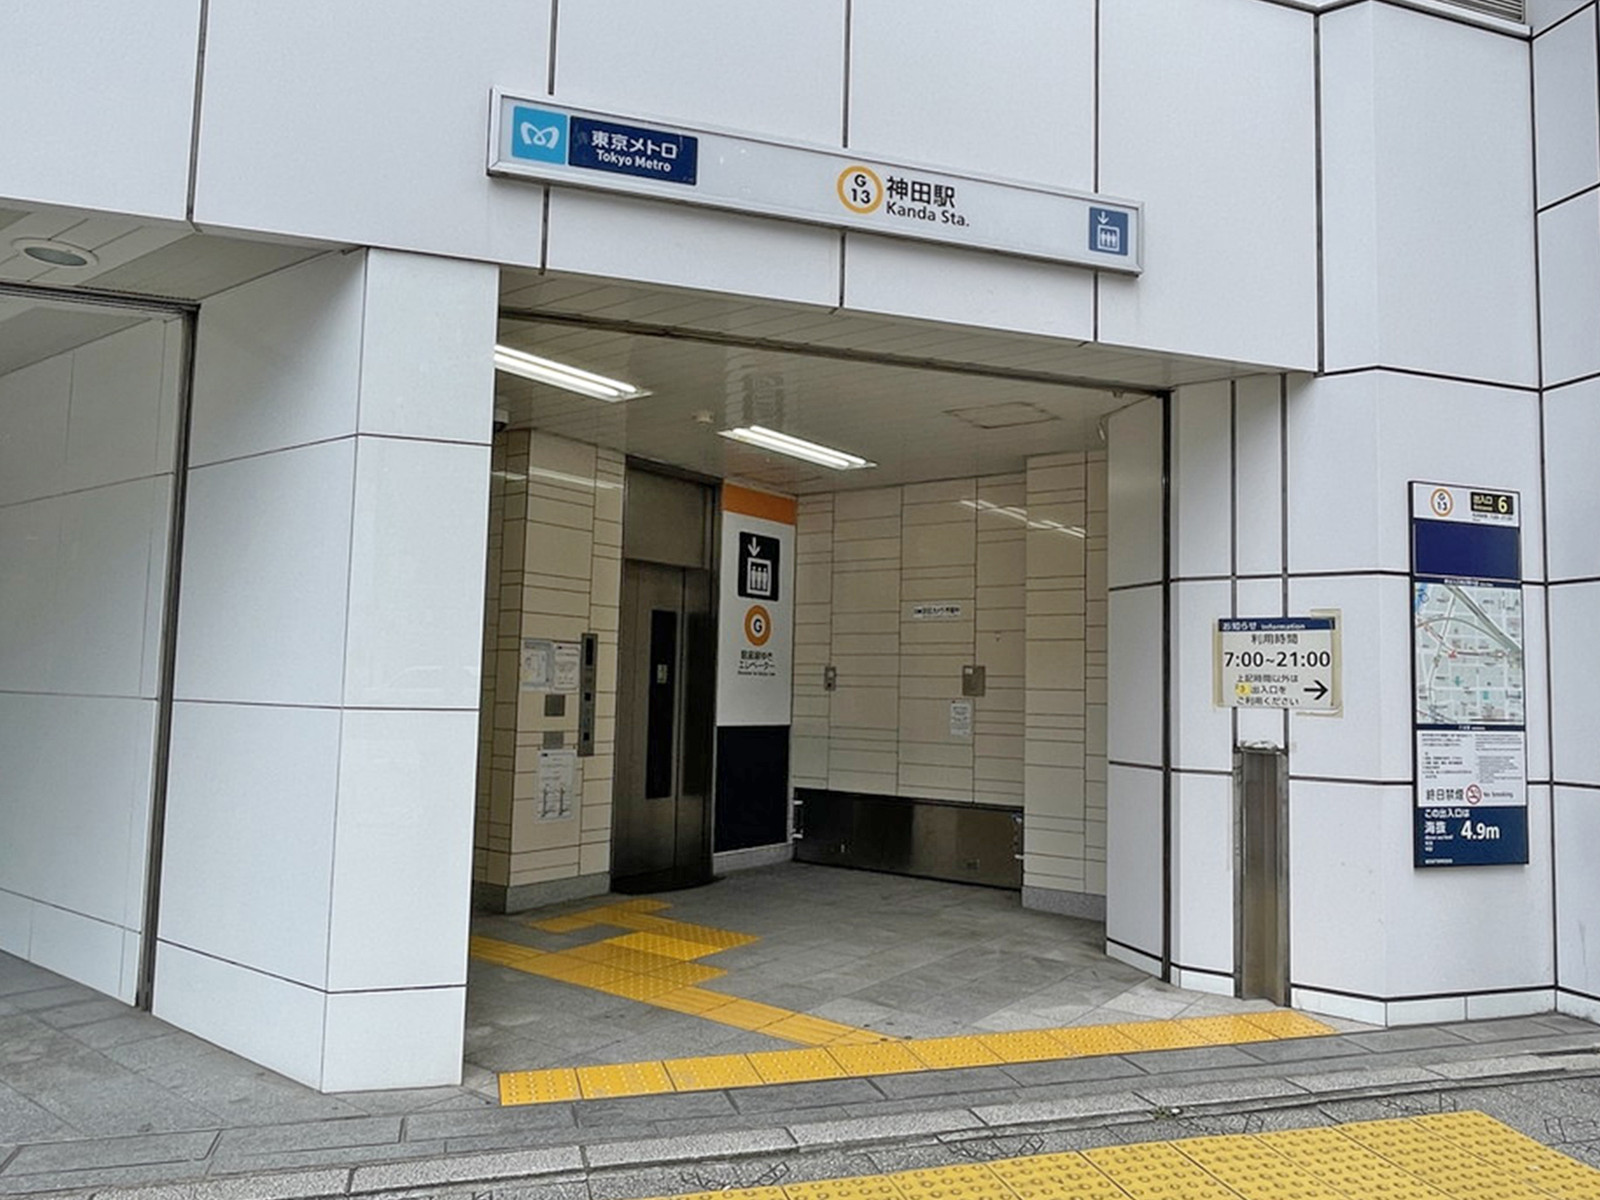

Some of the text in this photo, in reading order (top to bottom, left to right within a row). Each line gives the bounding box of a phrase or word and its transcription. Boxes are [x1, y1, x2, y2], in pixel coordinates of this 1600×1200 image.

[591, 130, 678, 159] 東京メトロ
[596, 149, 672, 172] Tokyo Metro
[854, 174, 867, 188] G
[851, 188, 871, 204] 13
[886, 176, 955, 208] 神田駅
[886, 201, 970, 227] Kanda Sta.
[1498, 496, 1508, 513] 6
[753, 618, 762, 633] G
[1222, 621, 1257, 630] お知らせ
[1251, 633, 1298, 645] 利用時間
[1236, 697, 1300, 706] ご利用ください
[1426, 788, 1463, 801] 終日禁煙
[1460, 819, 1500, 841] 4.9m
